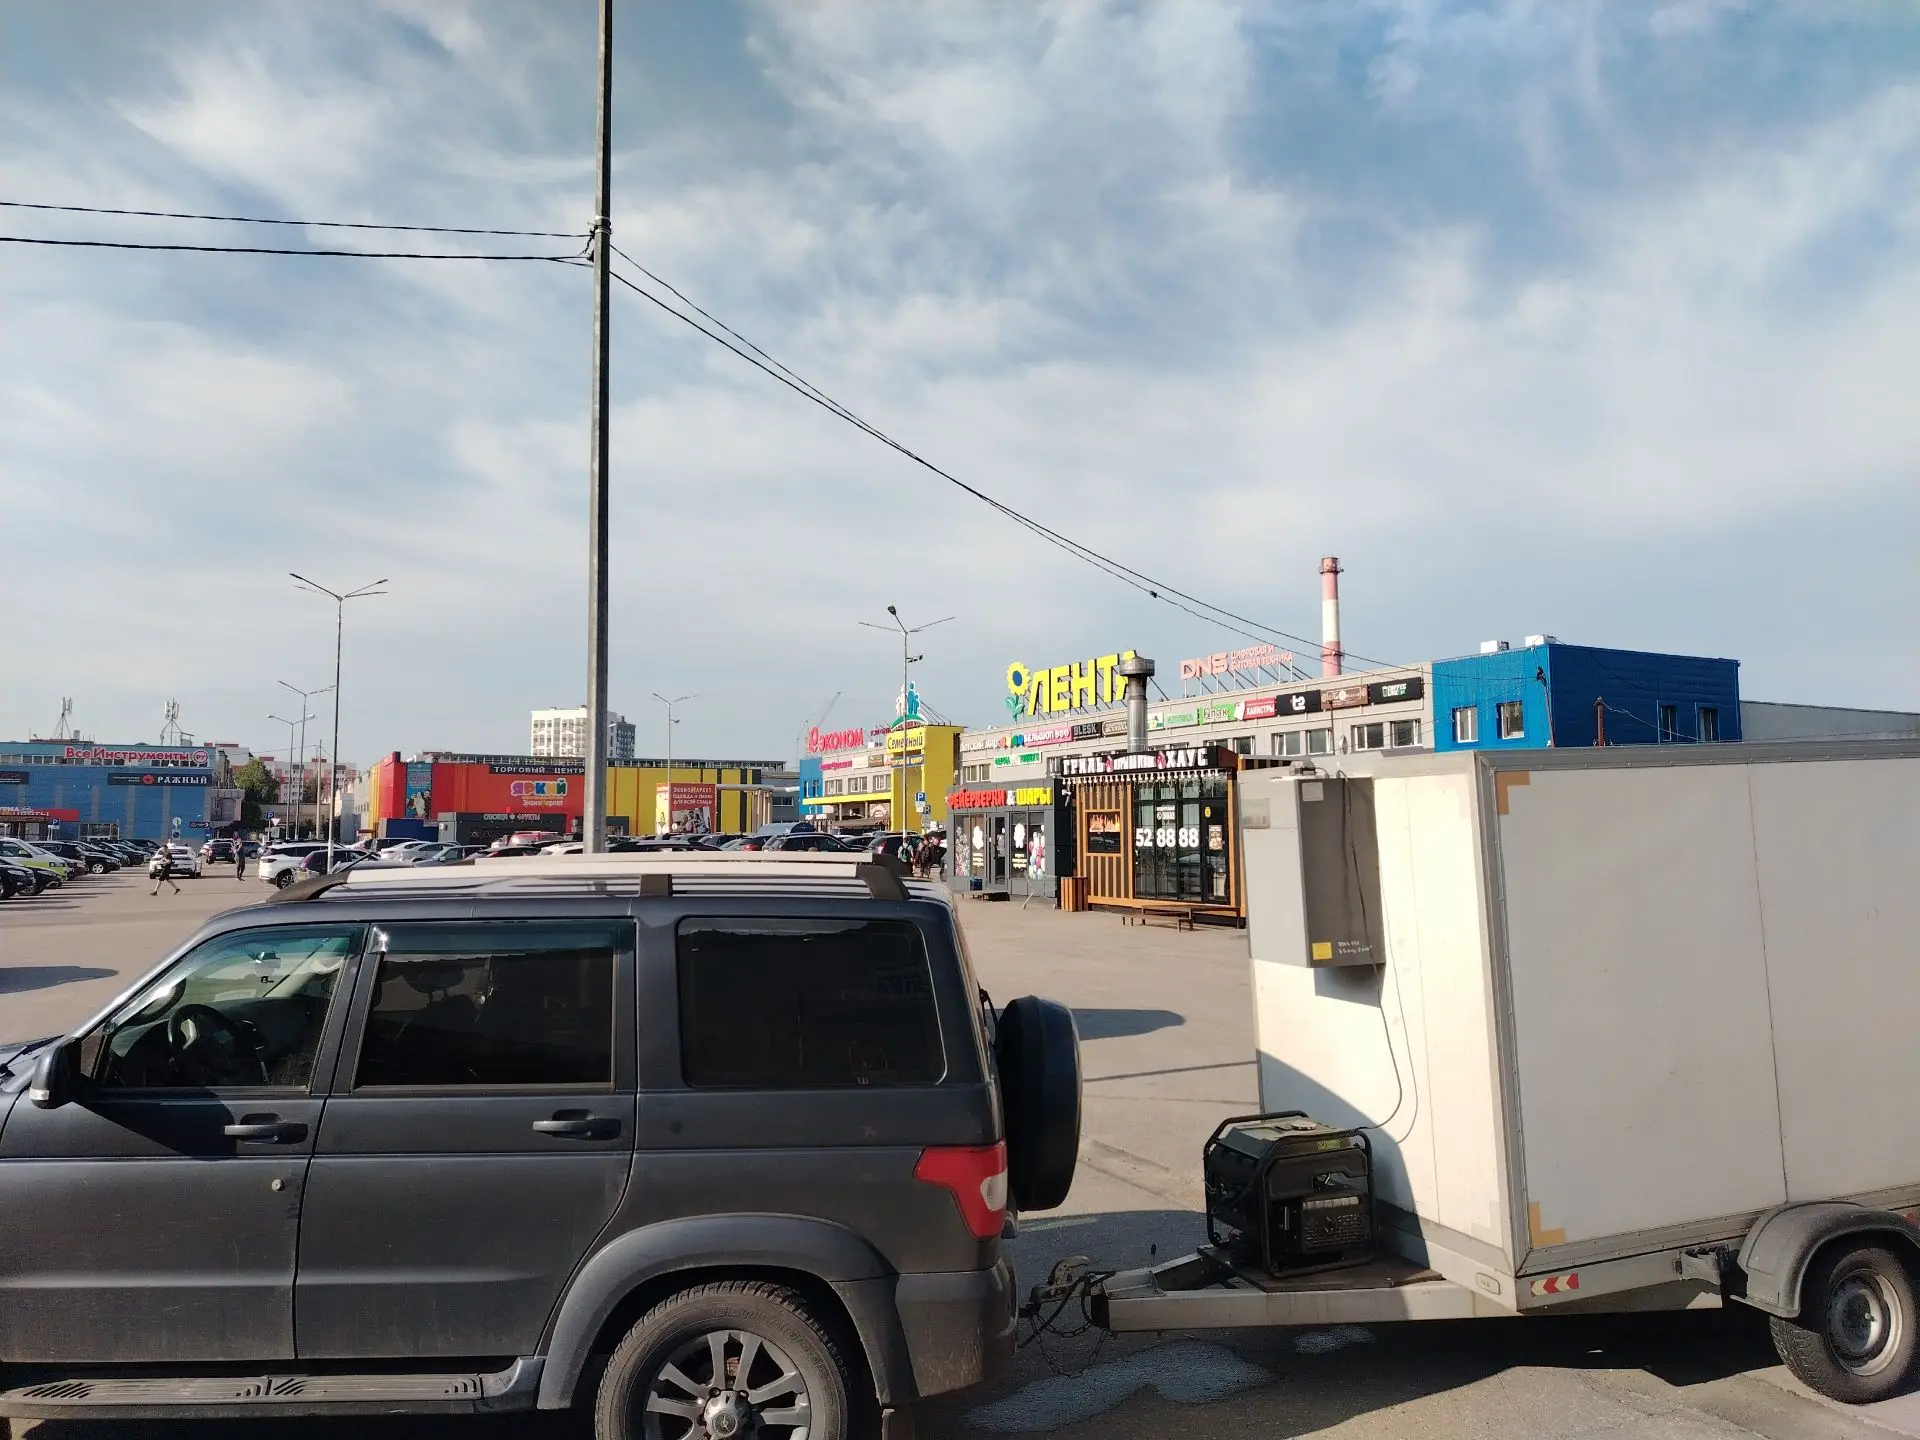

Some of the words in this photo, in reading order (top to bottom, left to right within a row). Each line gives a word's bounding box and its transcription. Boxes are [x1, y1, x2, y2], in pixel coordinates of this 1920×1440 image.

[1230, 645, 1267, 660] ЦИФРОВАЯ
[1260, 652, 1294, 666] ТЕХНИКА
[1180, 652, 1229, 680] DNS
[1073, 723, 1097, 736] BLESK
[1063, 757, 1105, 775] ГРИЛЬ
[1165, 747, 1208, 769] ХАУС
[157, 775, 208, 784] РАЖНЫЙ
[511, 778, 568, 797] ЯРКИЙ
[946, 789, 1006, 809] ФЕЙЕРВЕРКИ
[1006, 789, 1016, 806] &
[1015, 787, 1053, 806] ШАРЫ
[1135, 828, 1153, 847] 52
[1156, 827, 1176, 848] 88
[1178, 827, 1200, 848] 88
